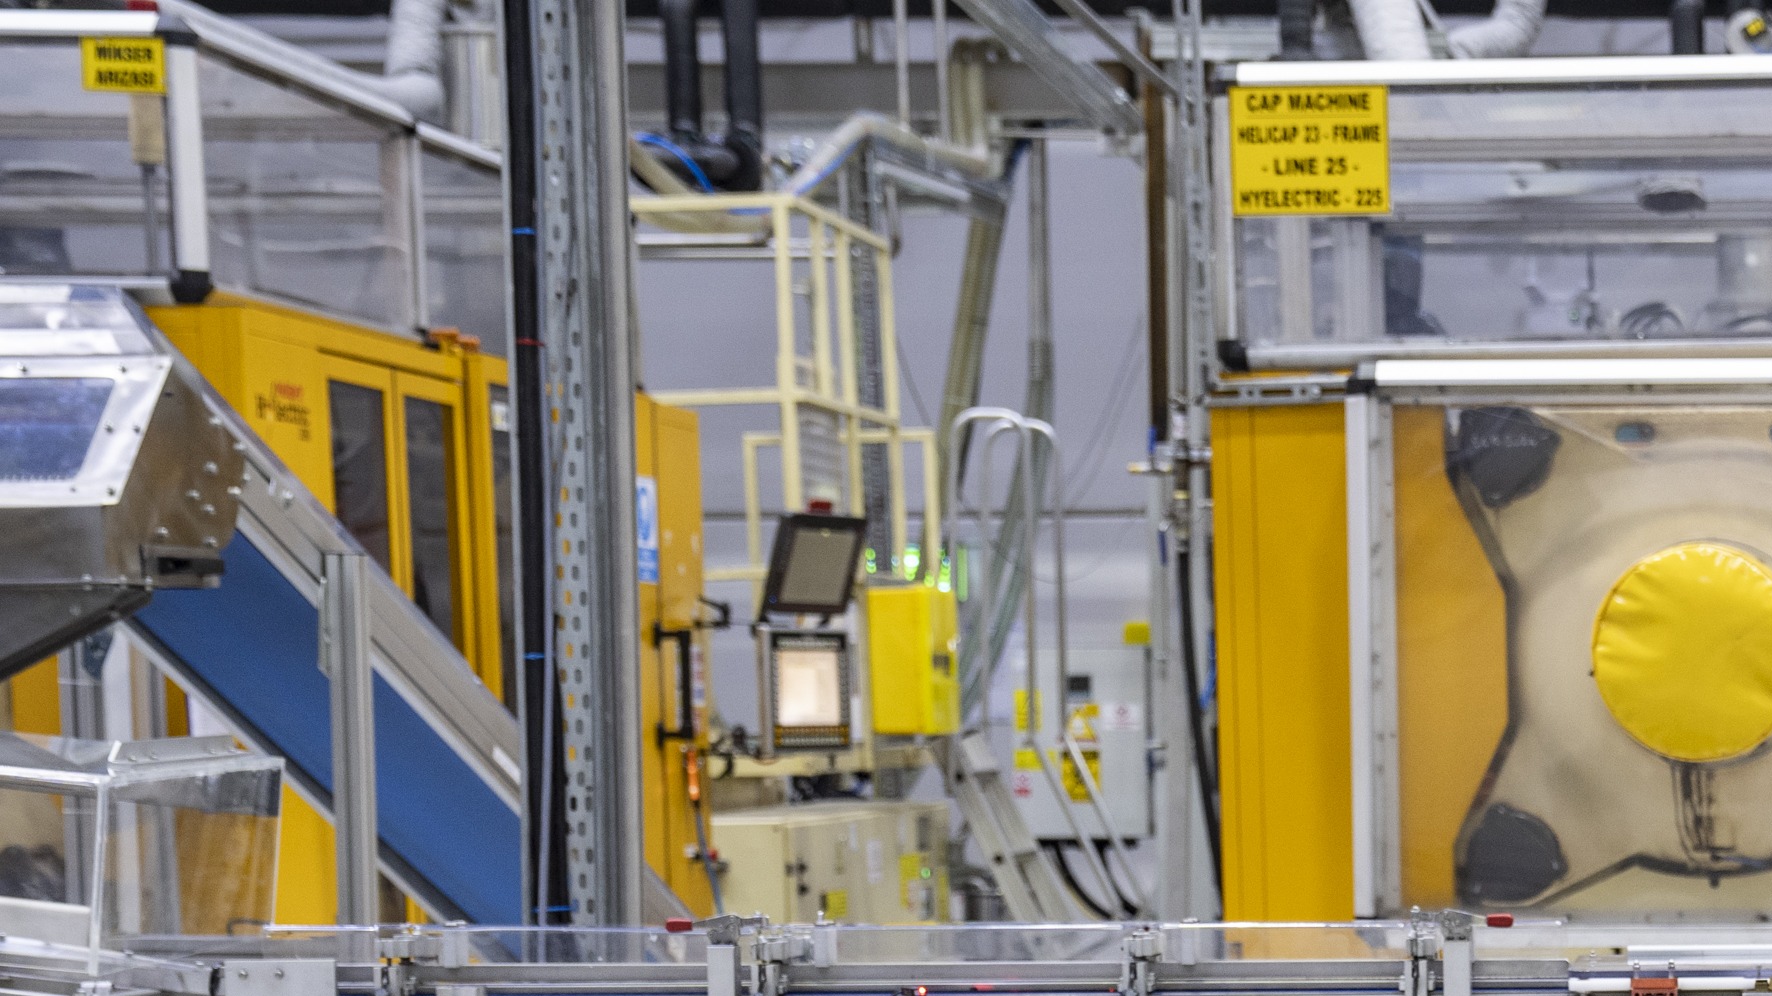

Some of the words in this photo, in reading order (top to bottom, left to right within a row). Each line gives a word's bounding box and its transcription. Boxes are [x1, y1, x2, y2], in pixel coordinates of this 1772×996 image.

[1247, 93, 1281, 112] CAP
[1288, 93, 1370, 111] MACHINE
[1238, 126, 1298, 143] HELICAP
[1304, 125, 1320, 143] 23
[1333, 125, 1380, 142] FRAME
[1274, 158, 1318, 175] LINE
[1326, 157, 1348, 175] 25
[1240, 190, 1340, 207] HYELECTRIC
[1356, 189, 1382, 207] 225
